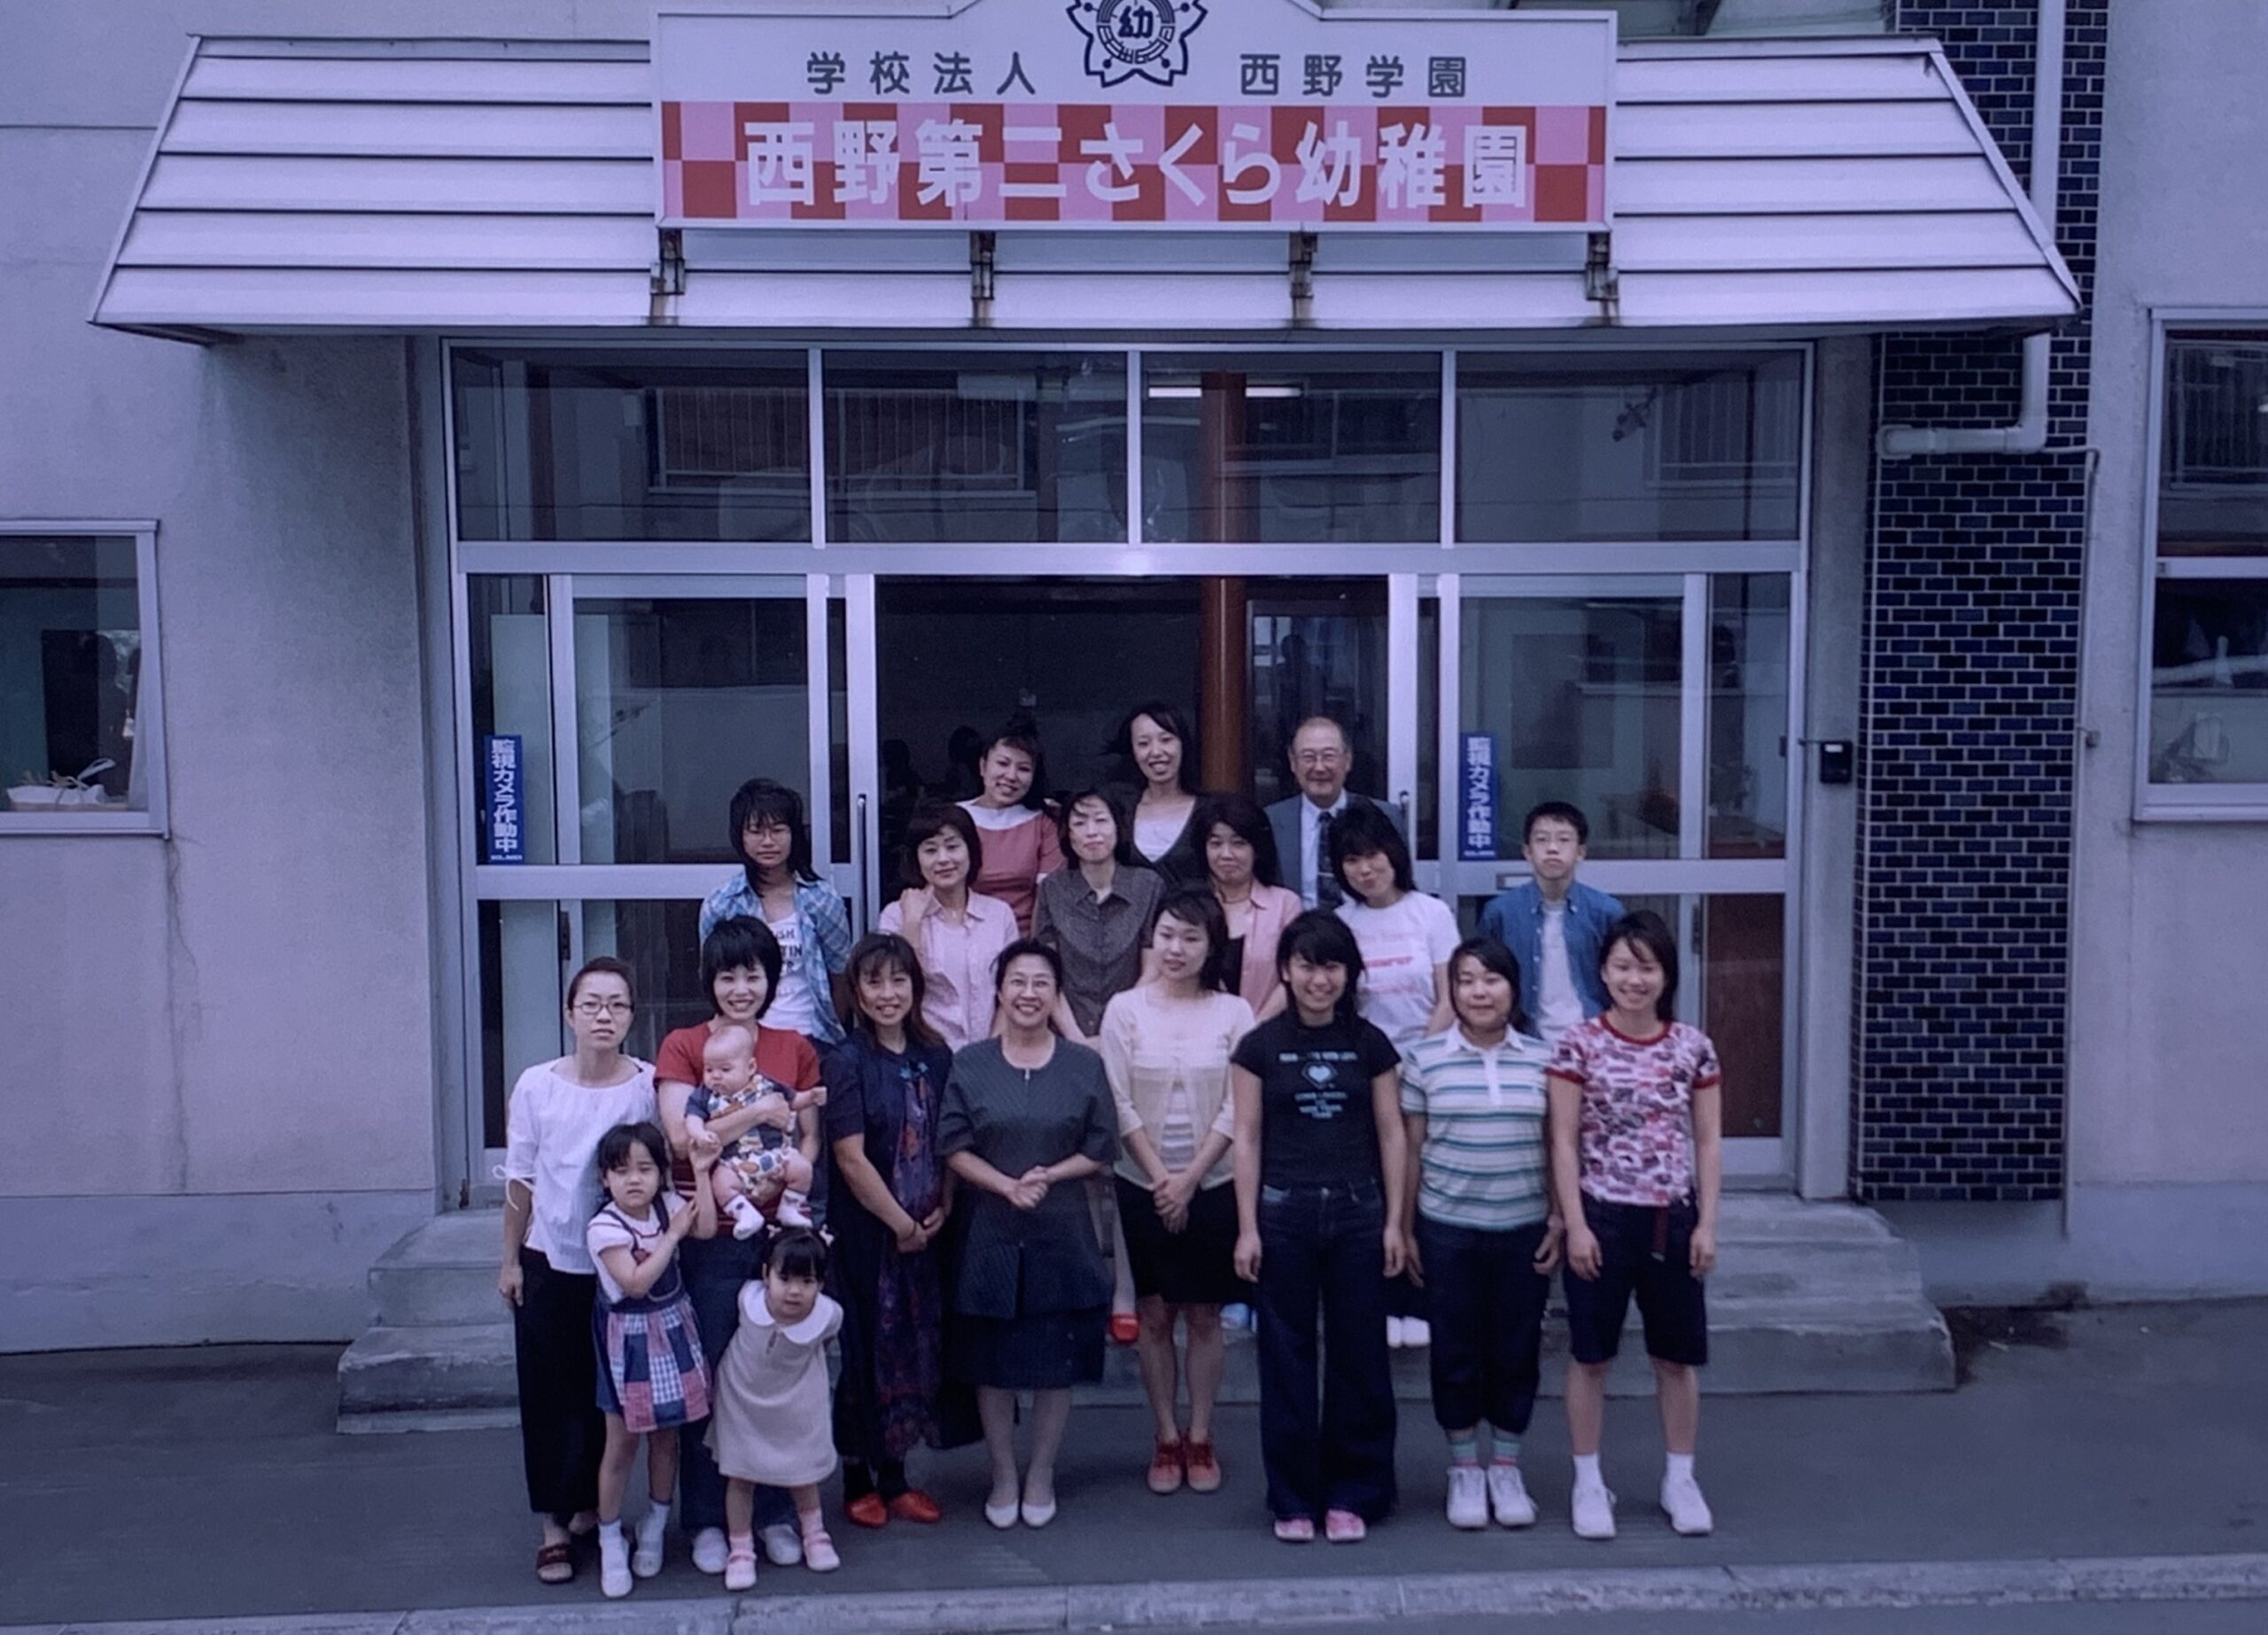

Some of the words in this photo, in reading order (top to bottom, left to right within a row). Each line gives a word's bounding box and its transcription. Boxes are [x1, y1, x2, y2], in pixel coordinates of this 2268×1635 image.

[807, 50, 1036, 96] 学校法人
[1242, 52, 1467, 98] 西野学園
[744, 118, 1526, 210] 西野第二さくら幼稚園
[492, 739, 517, 853] 監視カメラ作動中
[1466, 737, 1491, 848] 監視カメラ作動中
